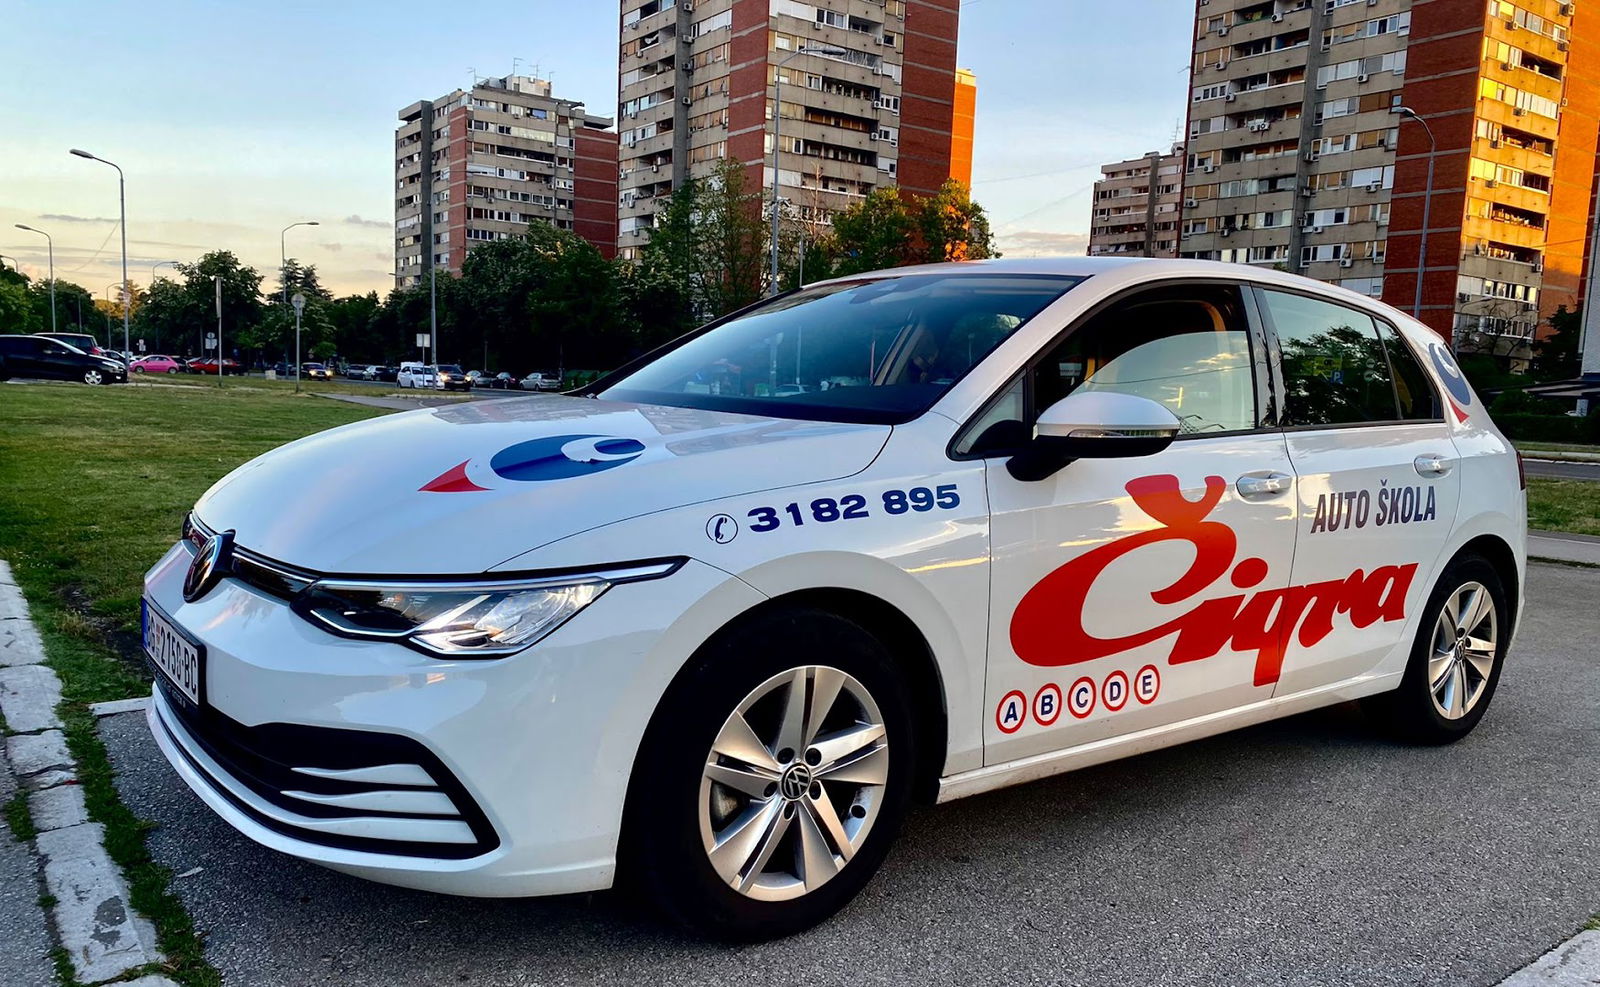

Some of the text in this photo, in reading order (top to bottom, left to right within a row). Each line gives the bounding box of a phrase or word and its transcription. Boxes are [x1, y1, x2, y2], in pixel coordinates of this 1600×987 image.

[747, 483, 960, 532] 3182 895
[1310, 479, 1436, 534] AUTO ŠKOLA
[1003, 674, 1153, 724] A B C D E
